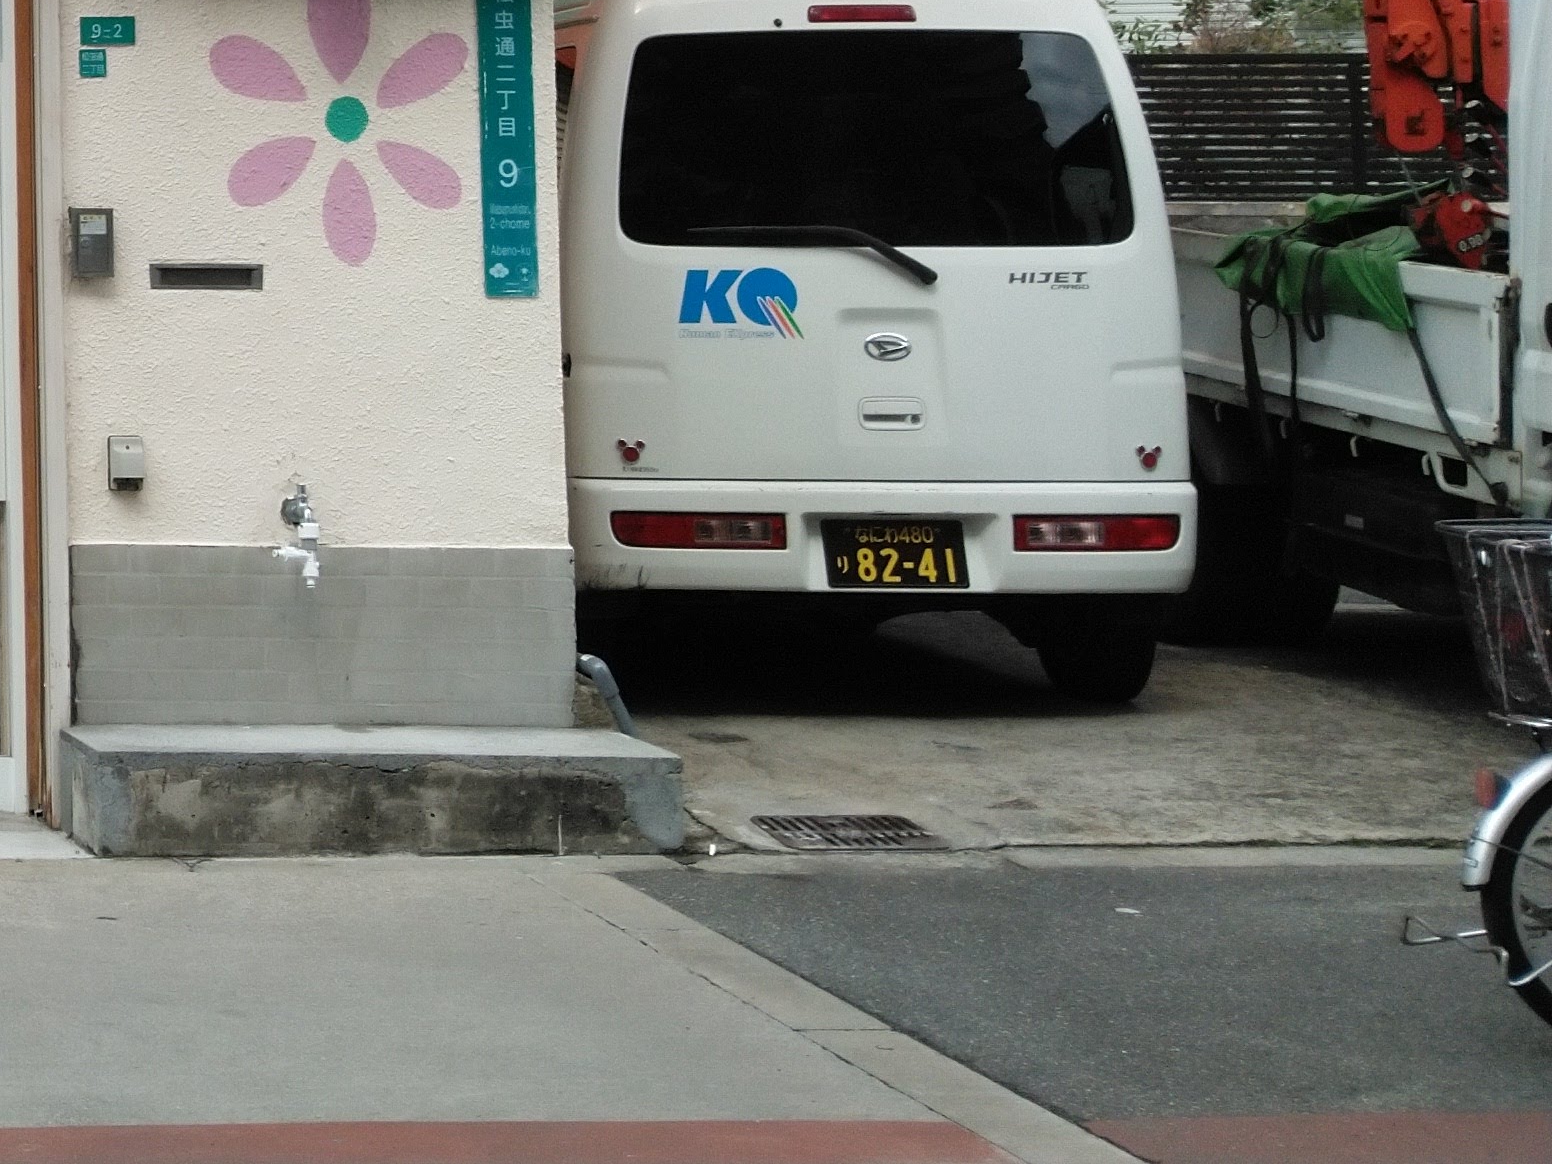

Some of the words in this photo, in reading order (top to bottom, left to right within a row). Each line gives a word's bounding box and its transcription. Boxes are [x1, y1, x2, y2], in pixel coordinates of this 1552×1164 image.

[91, 23, 124, 39] 9-2
[498, 157, 519, 188] 9
[1008, 271, 1088, 284] HIJET
[678, 267, 804, 339] KQ
[857, 547, 957, 583] 82-41
